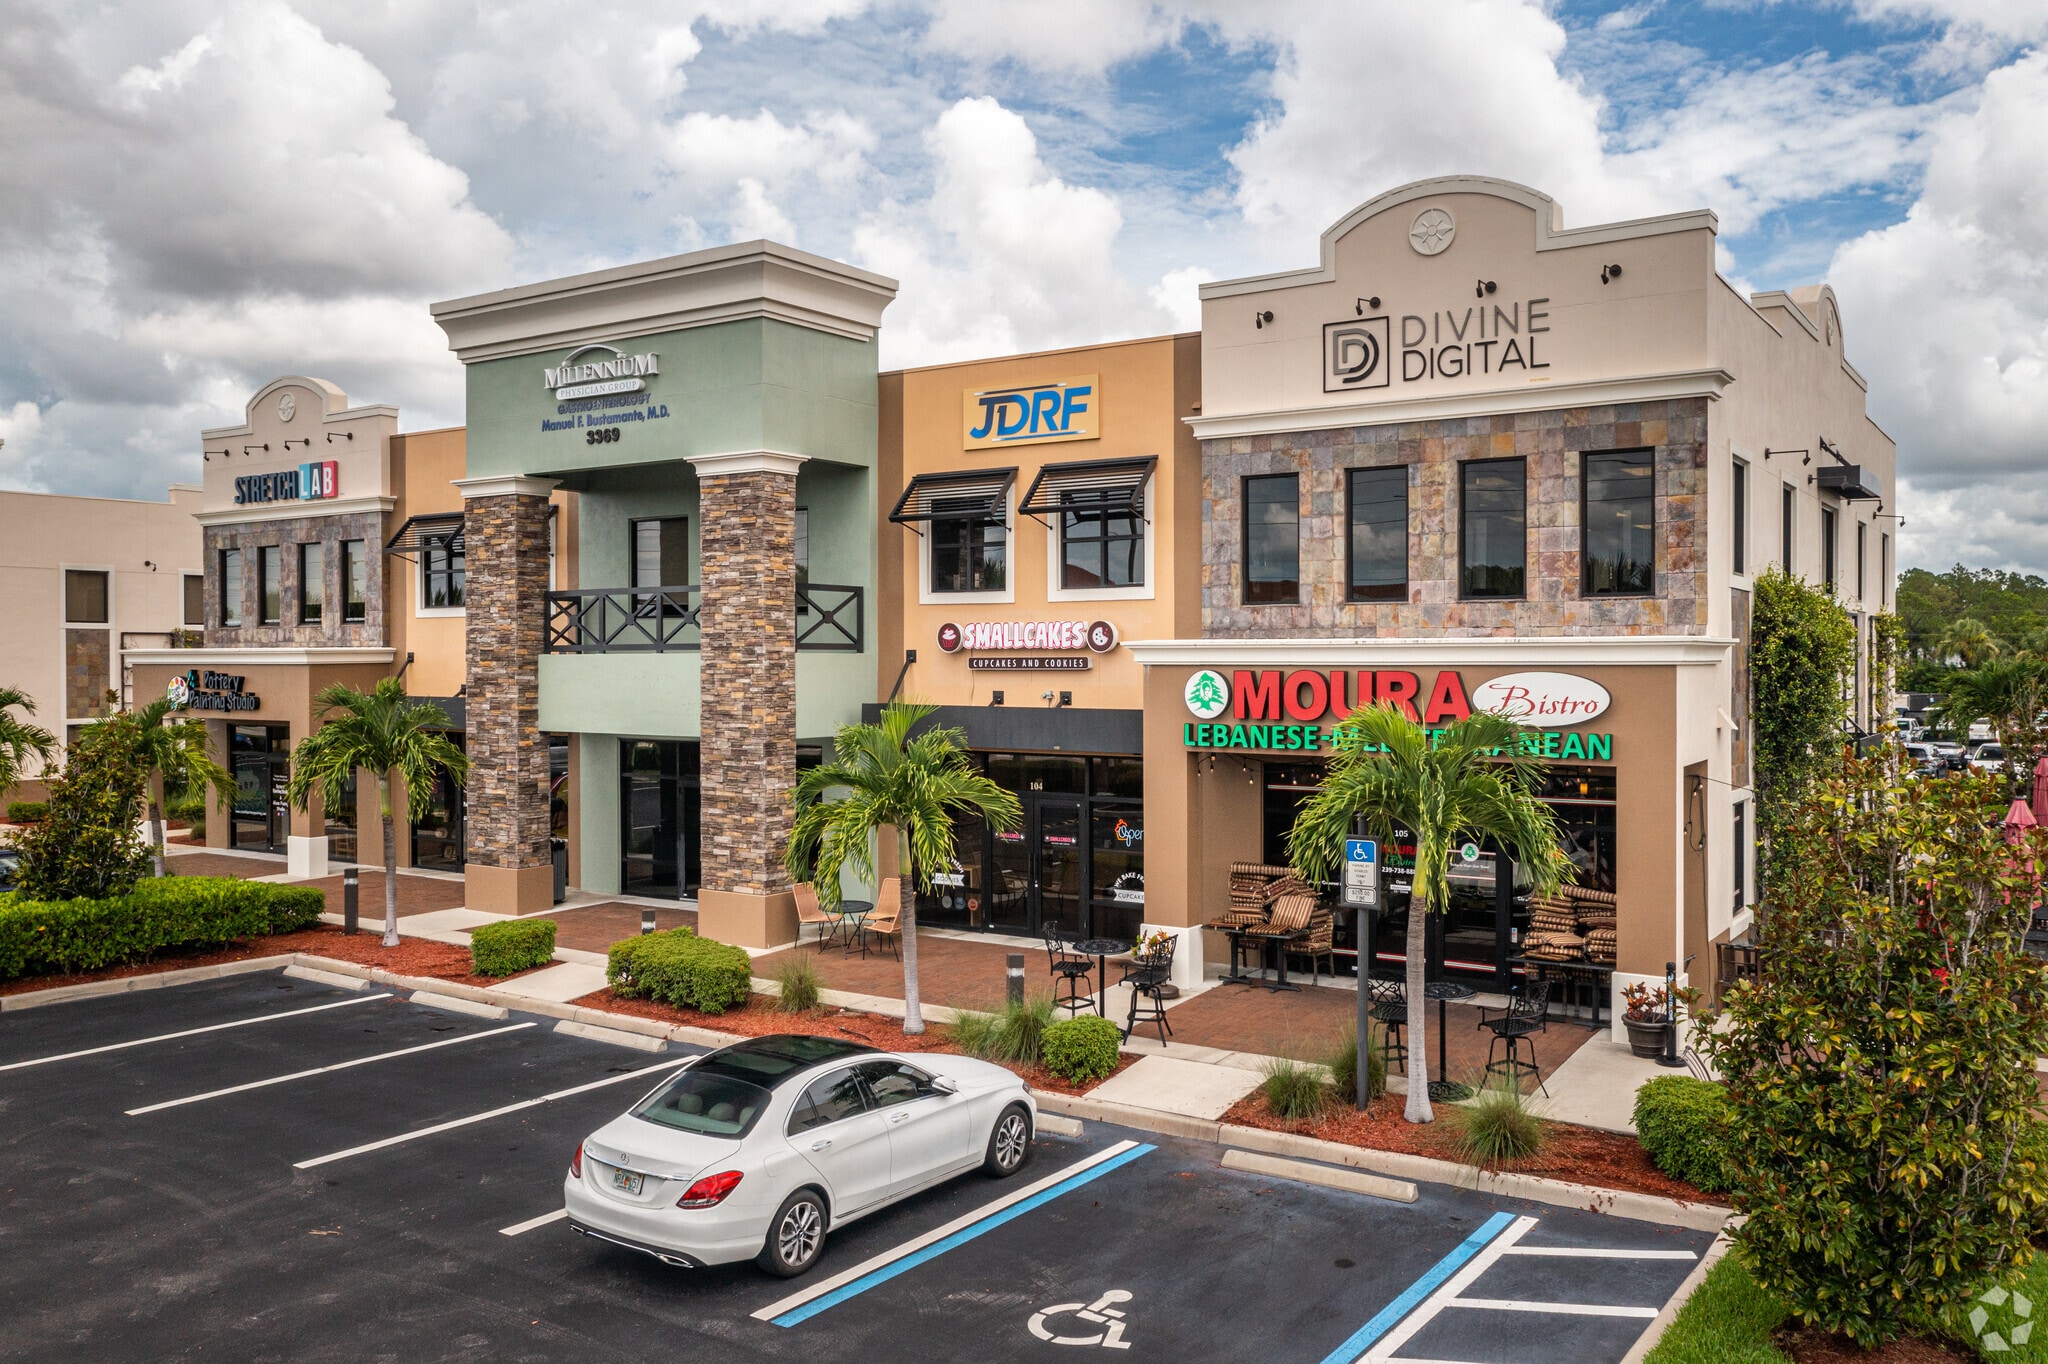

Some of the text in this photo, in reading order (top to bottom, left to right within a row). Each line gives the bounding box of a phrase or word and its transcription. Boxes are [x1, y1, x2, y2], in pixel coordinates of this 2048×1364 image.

[1402, 298, 1550, 347] DIVINE
[544, 352, 660, 389] MILLENNIUM
[1402, 336, 1550, 382] DIGITAL
[560, 381, 637, 398] PHYSICIAN GROUP
[557, 393, 651, 415] GASTROENTEROLOGY
[969, 386, 1092, 439] JDRF
[542, 404, 670, 432] Manuel F. Bustamante, M.D.
[586, 427, 620, 445] 3369
[963, 621, 1085, 650] SMALLCAKES
[973, 659, 1084, 668] CUPCAKES AND COOKIES
[203, 671, 242, 692] Pottery
[189, 689, 228, 712] Painting
[226, 691, 257, 710] Studio
[1233, 670, 1599, 724] MOURA Bistro
[1030, 781, 1043, 791] 104
[1394, 830, 1408, 838] 105
